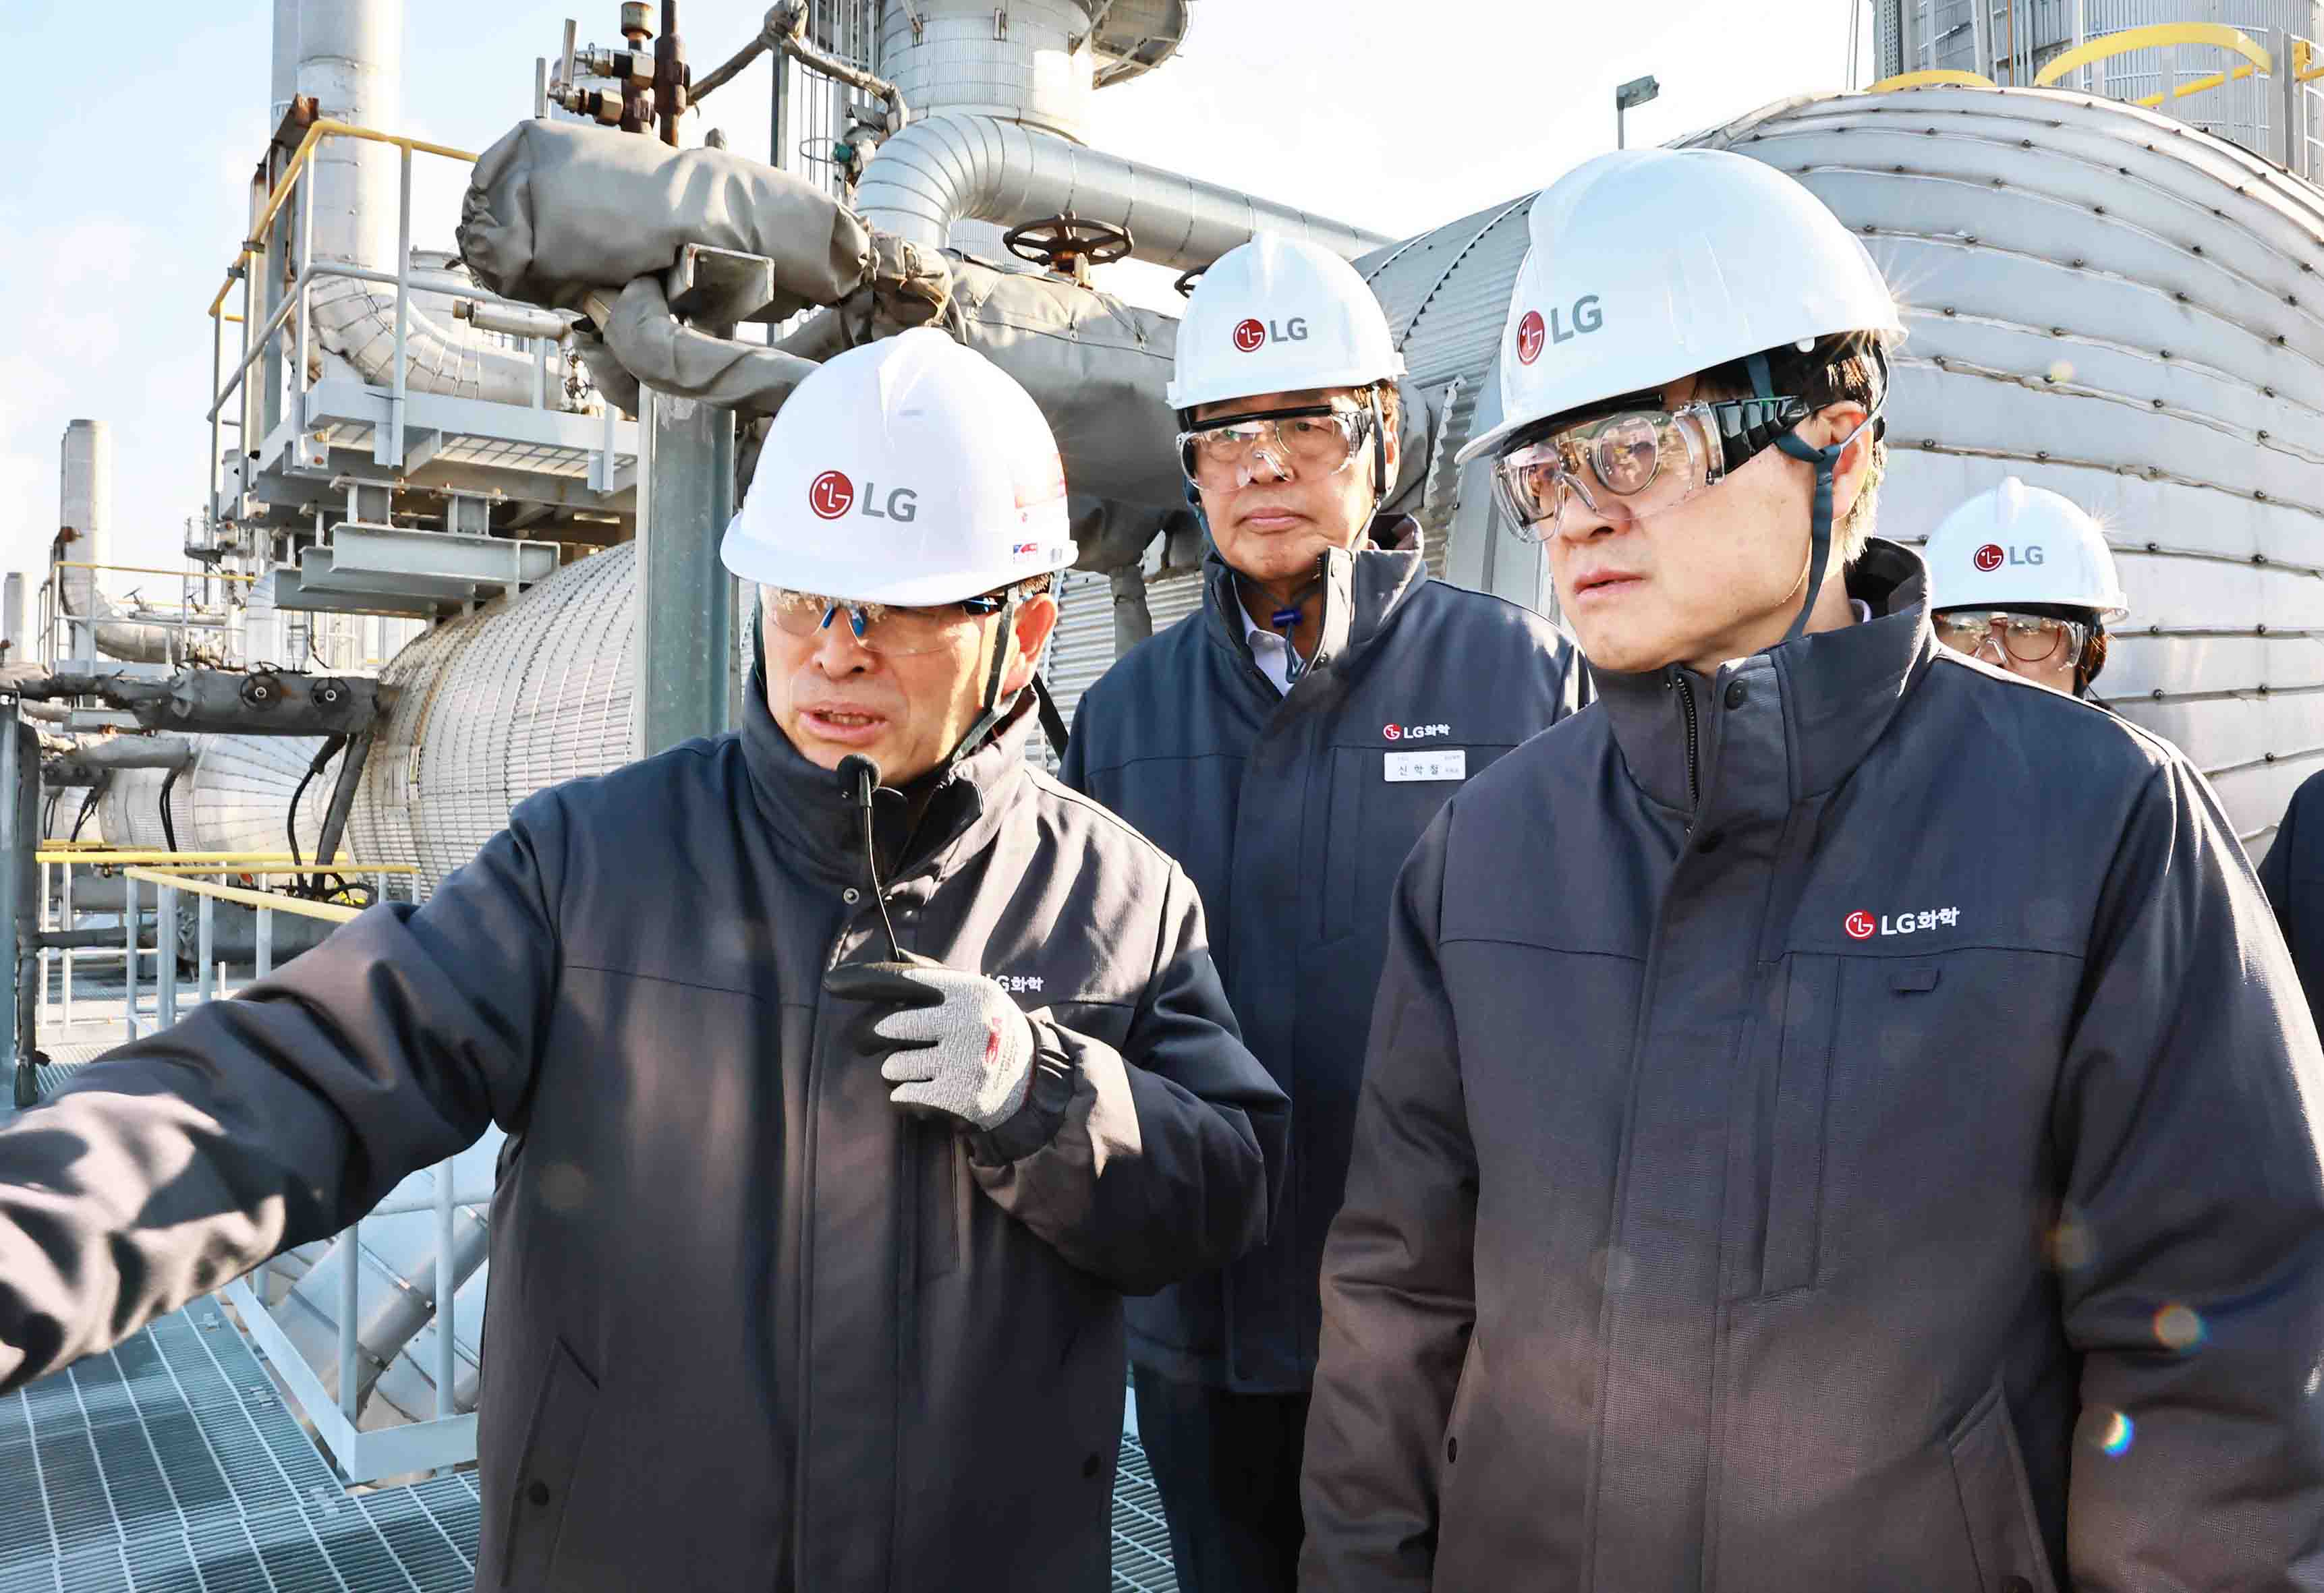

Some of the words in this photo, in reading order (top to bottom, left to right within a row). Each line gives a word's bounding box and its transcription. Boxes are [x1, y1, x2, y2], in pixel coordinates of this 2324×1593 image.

[1269, 318, 1308, 343] LG
[1550, 294, 1603, 345] LG
[861, 482, 918, 522] LG
[2009, 546, 2044, 565] LG
[1403, 724, 1450, 738] LG화학
[1881, 906, 1960, 935] LG화학
[986, 973, 1044, 993] G화학
